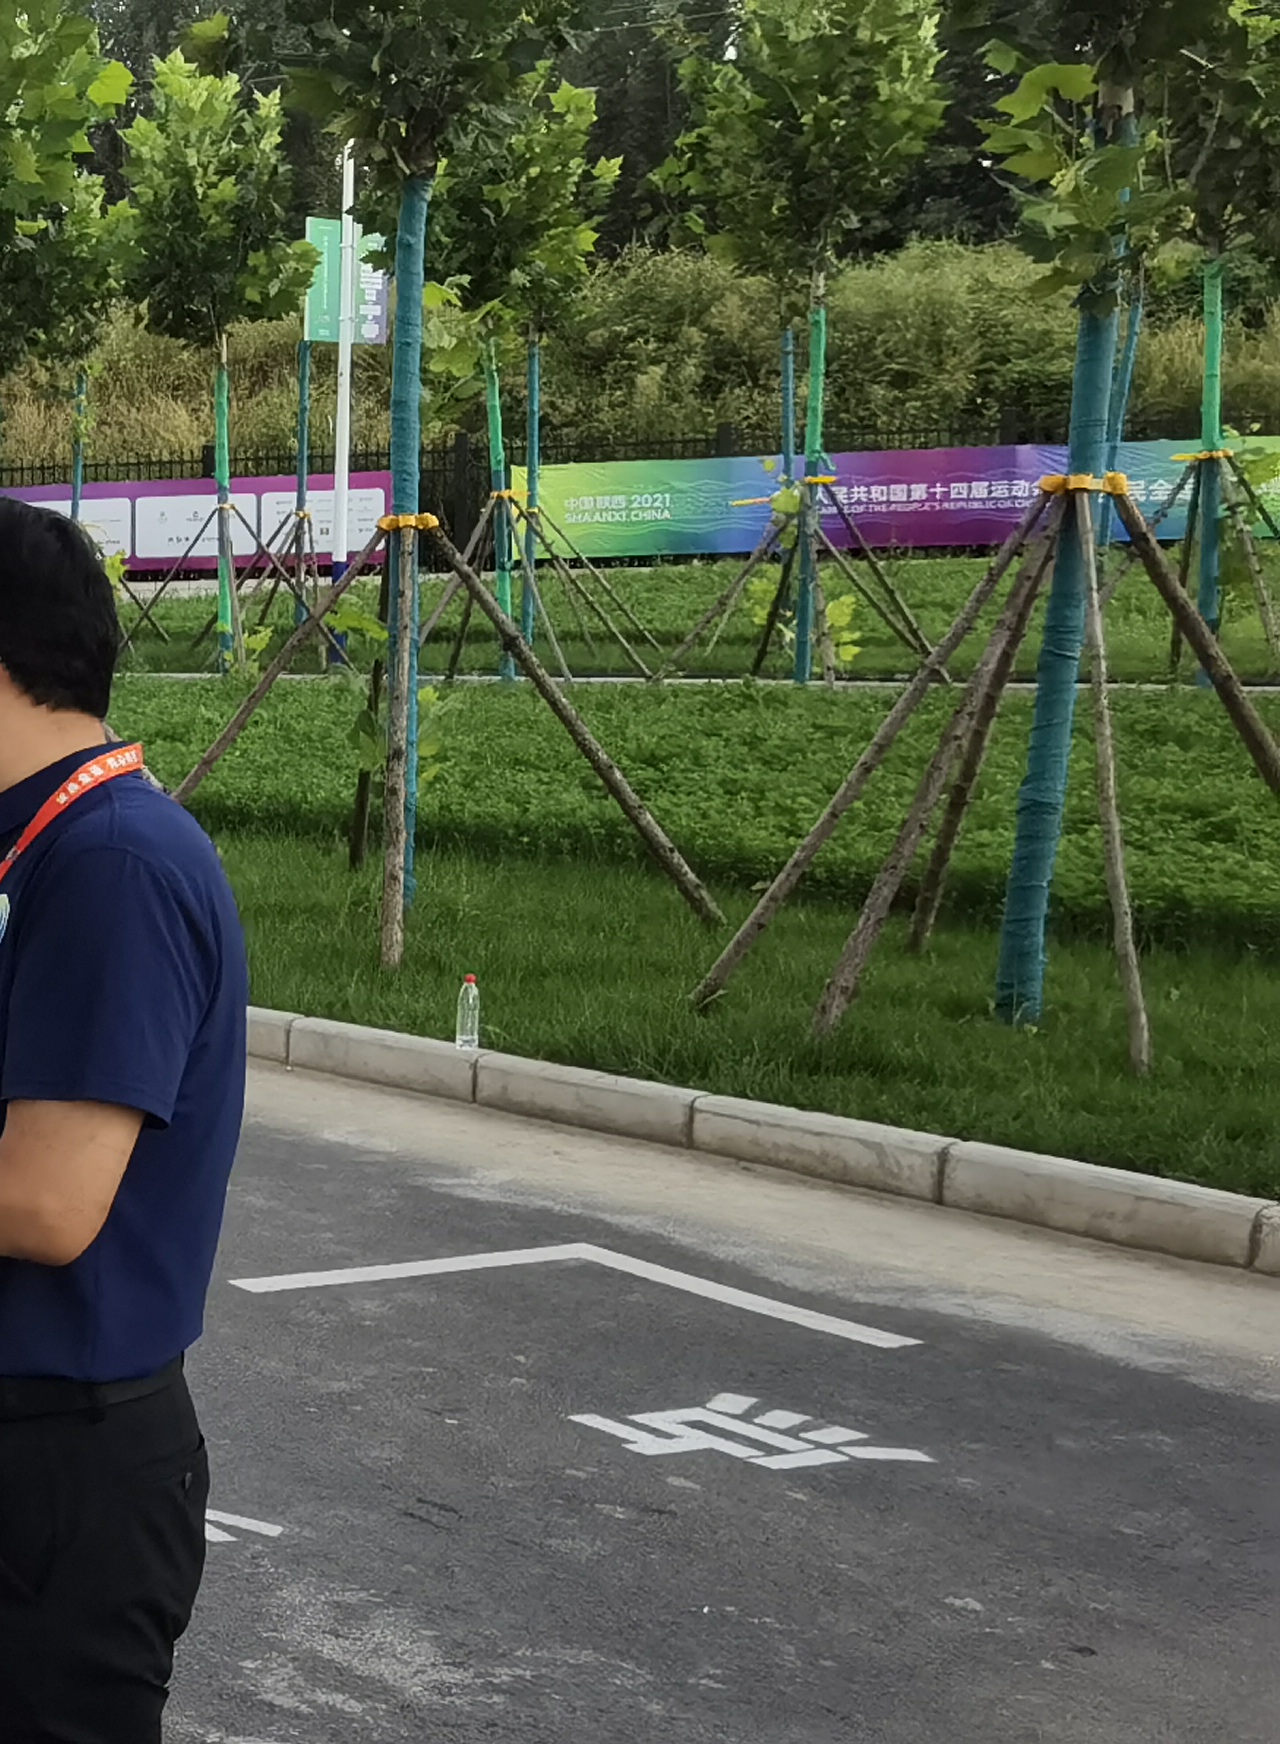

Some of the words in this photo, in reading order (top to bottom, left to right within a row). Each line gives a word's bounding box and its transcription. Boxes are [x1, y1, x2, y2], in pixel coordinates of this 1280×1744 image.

[630, 493, 671, 508] 2021
[565, 511, 627, 524] SHAANXI
[630, 509, 672, 521] CHINA
